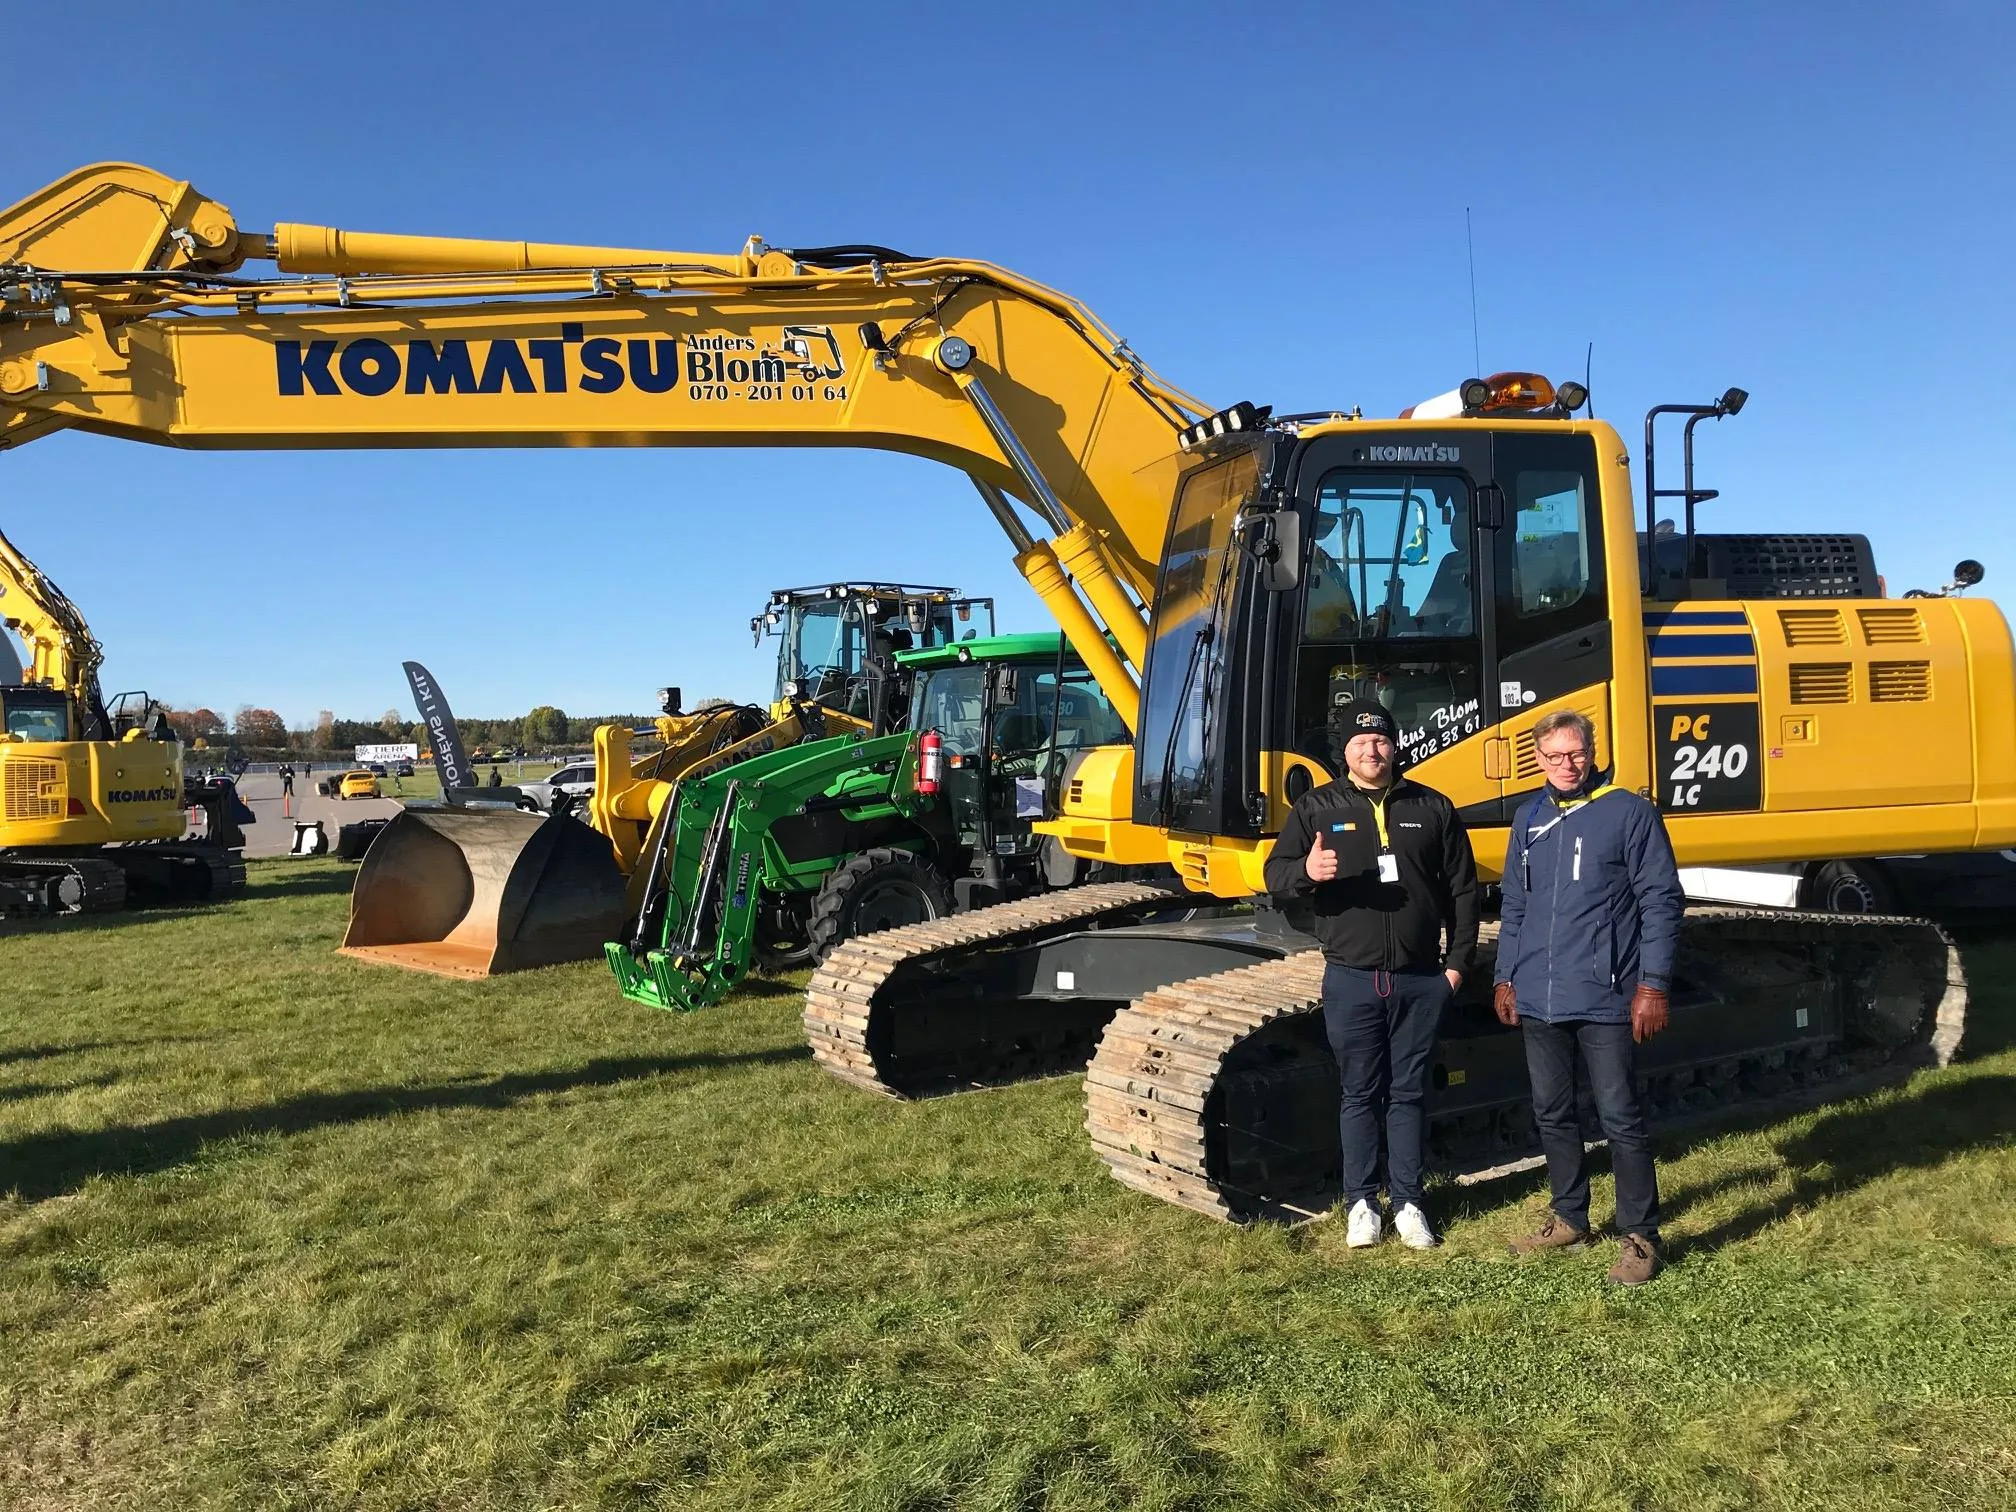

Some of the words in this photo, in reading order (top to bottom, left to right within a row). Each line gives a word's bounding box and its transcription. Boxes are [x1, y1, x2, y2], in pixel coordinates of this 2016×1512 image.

[687, 334, 755, 350] Anders
[274, 323, 680, 396] KOMATSU
[686, 351, 786, 383] Blom
[689, 385, 729, 401] 070
[747, 385, 783, 401] 201
[792, 385, 814, 401] 01
[823, 385, 847, 401] 64
[1369, 442, 1460, 462] KOMATSU
[1429, 698, 1479, 729] Blom
[1670, 714, 1711, 742] PC
[1410, 738, 1438, 764] 802
[1441, 725, 1459, 748] 38
[1464, 714, 1480, 734] 61
[1670, 744, 1749, 781] 240
[108, 785, 177, 804] KOMATSU
[1671, 784, 1702, 807] LC
[736, 852, 751, 892] TRIMA
